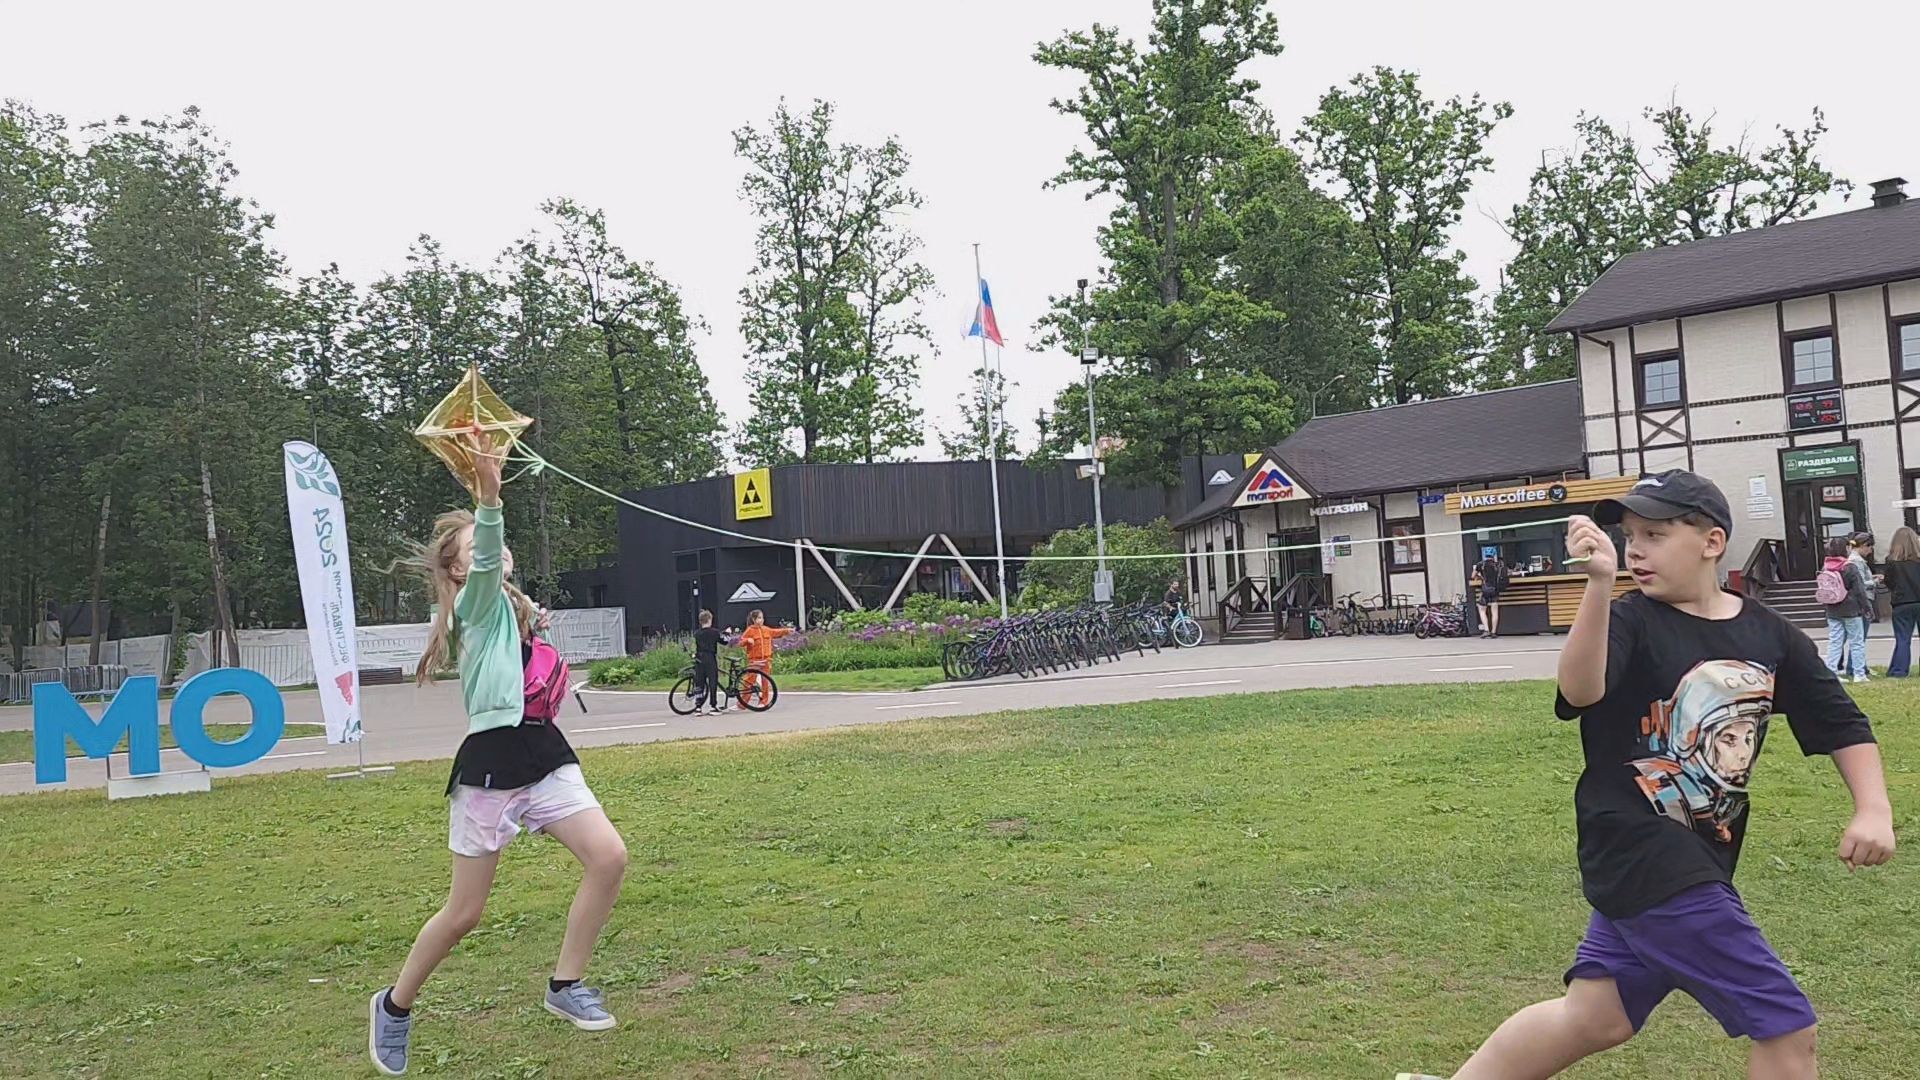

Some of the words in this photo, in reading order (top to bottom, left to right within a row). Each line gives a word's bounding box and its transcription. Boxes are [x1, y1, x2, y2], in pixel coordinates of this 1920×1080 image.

[1797, 455, 1856, 468] РАЗДЕВАЛКА
[1246, 486, 1294, 502] marsport
[1460, 494, 1496, 509] MAKE
[1497, 488, 1546, 504] coffee
[1309, 501, 1369, 517] МАГАЗИН
